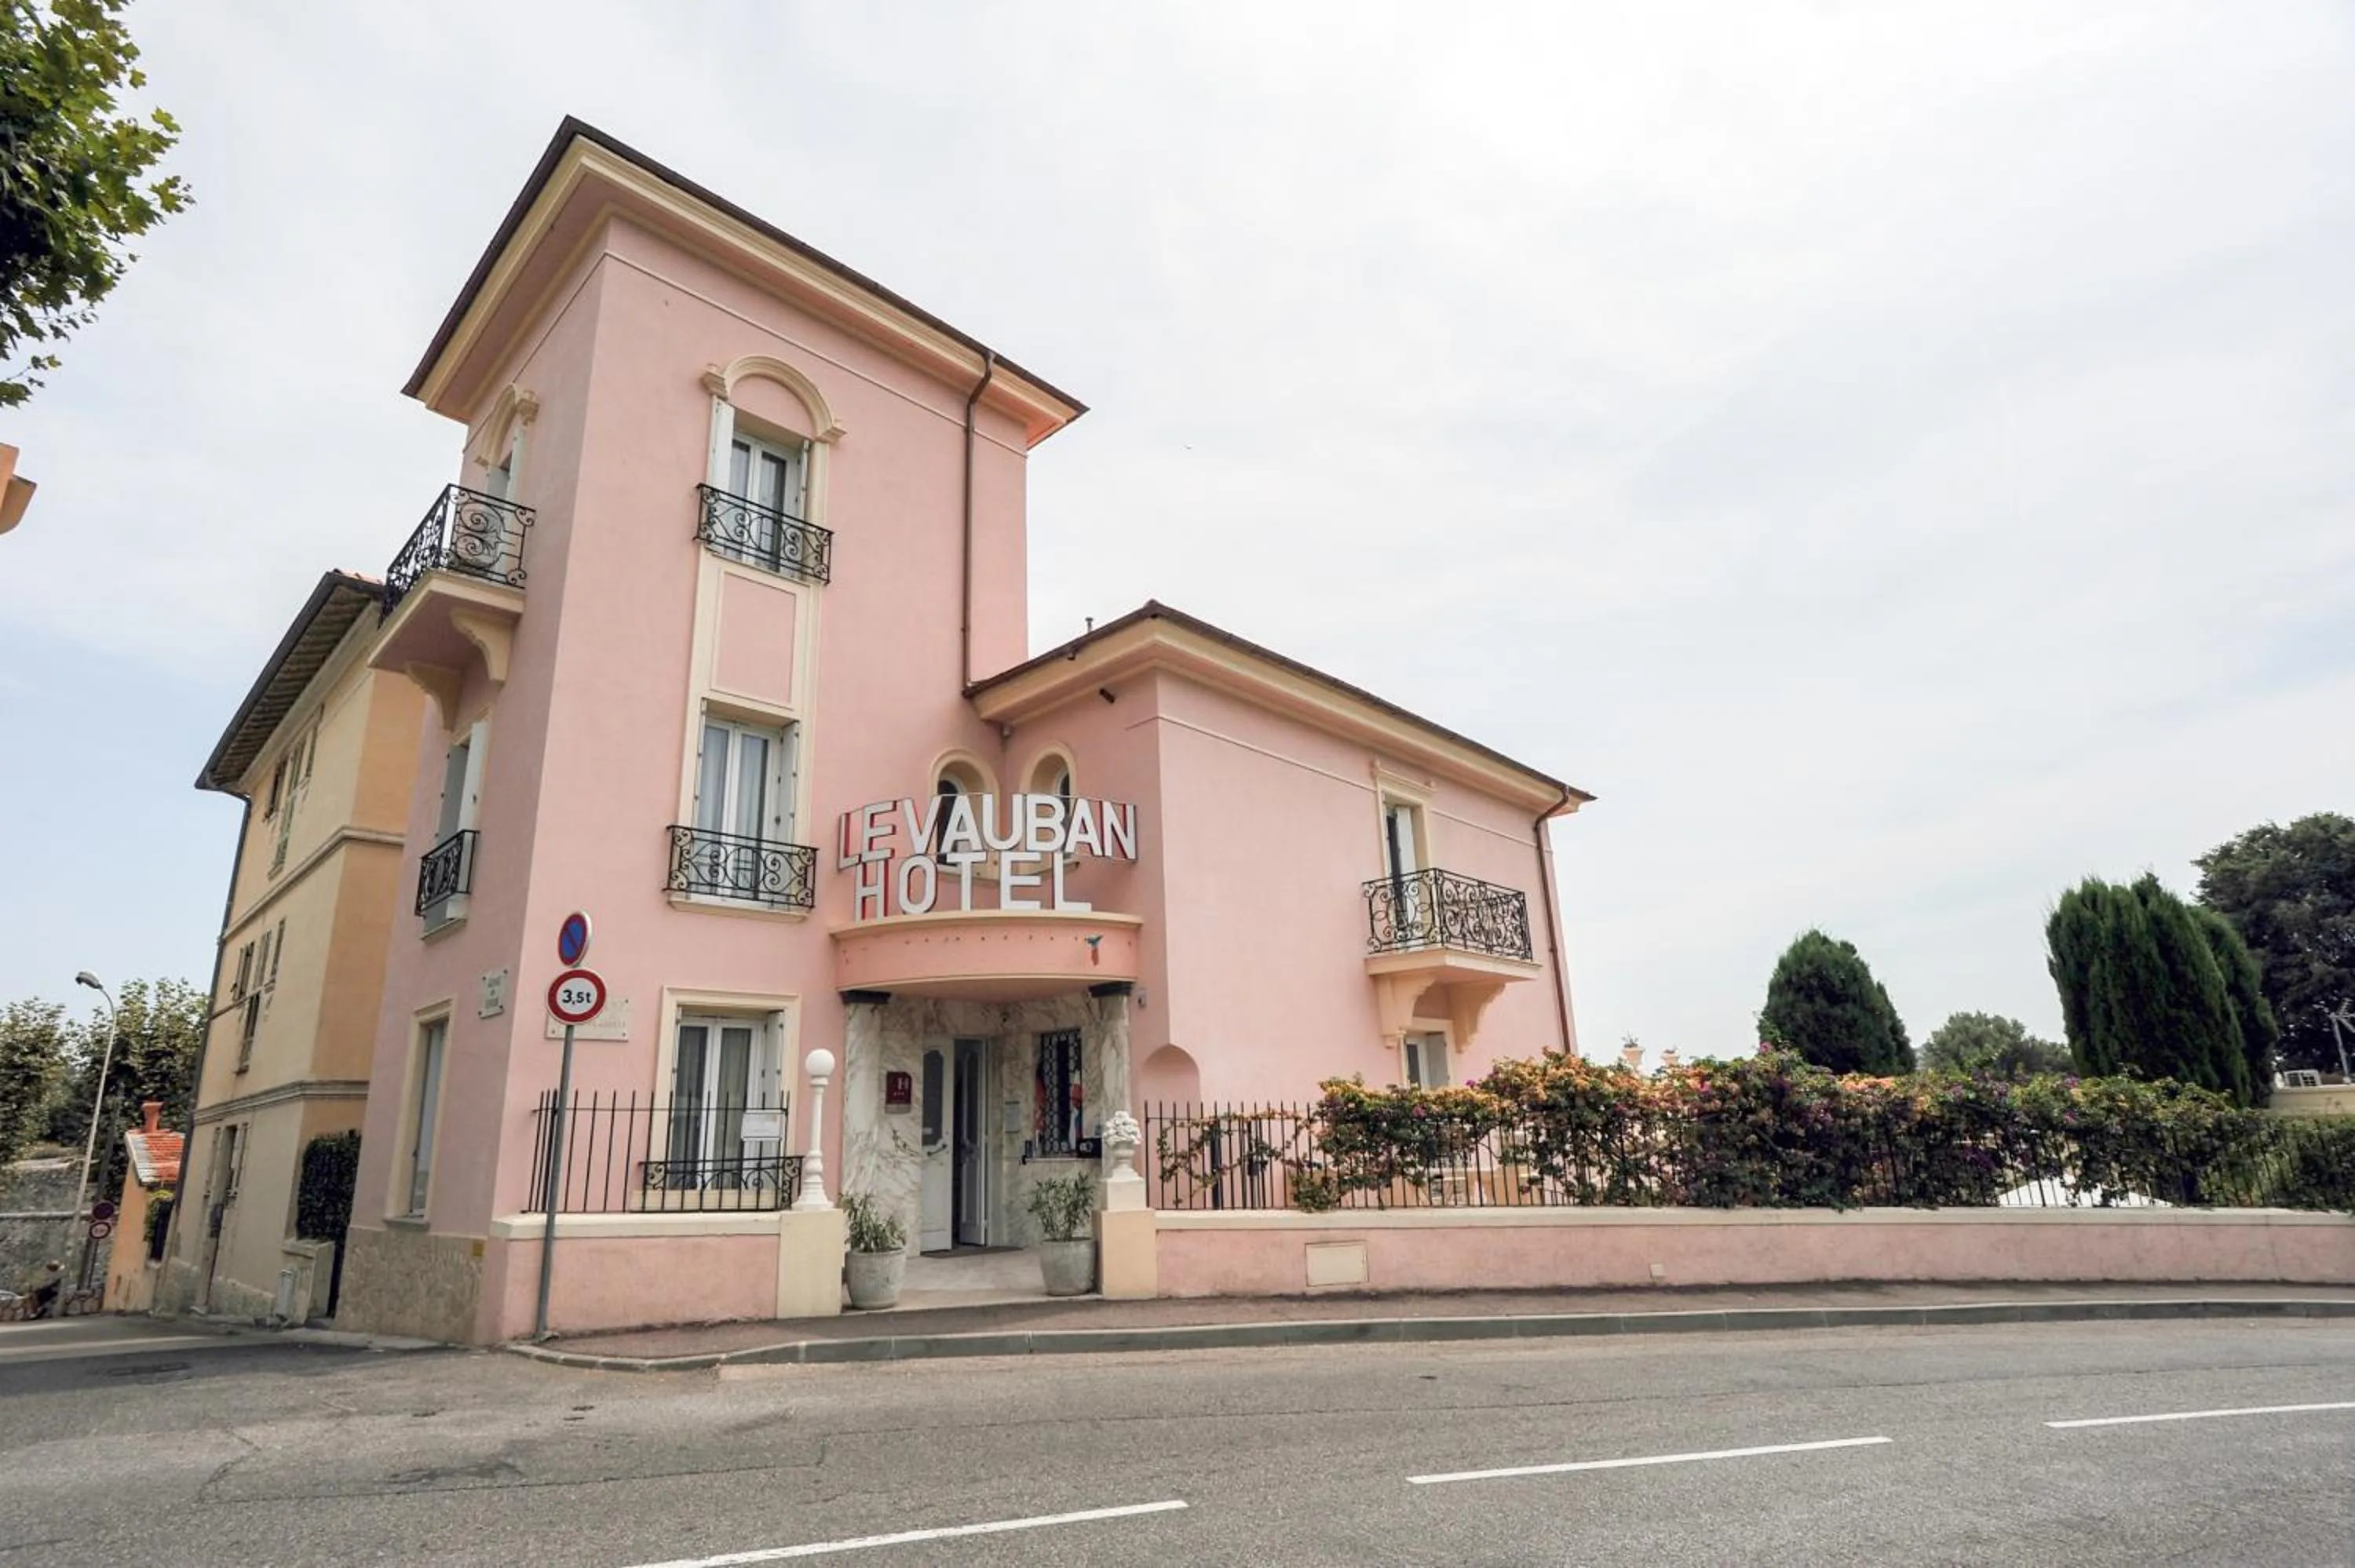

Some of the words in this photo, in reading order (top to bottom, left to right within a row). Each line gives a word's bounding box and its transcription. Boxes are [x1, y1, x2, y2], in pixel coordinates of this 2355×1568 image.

[838, 800, 896, 870] LE
[901, 793, 1137, 861] VAUBAN
[855, 851, 1093, 924] HOTEL
